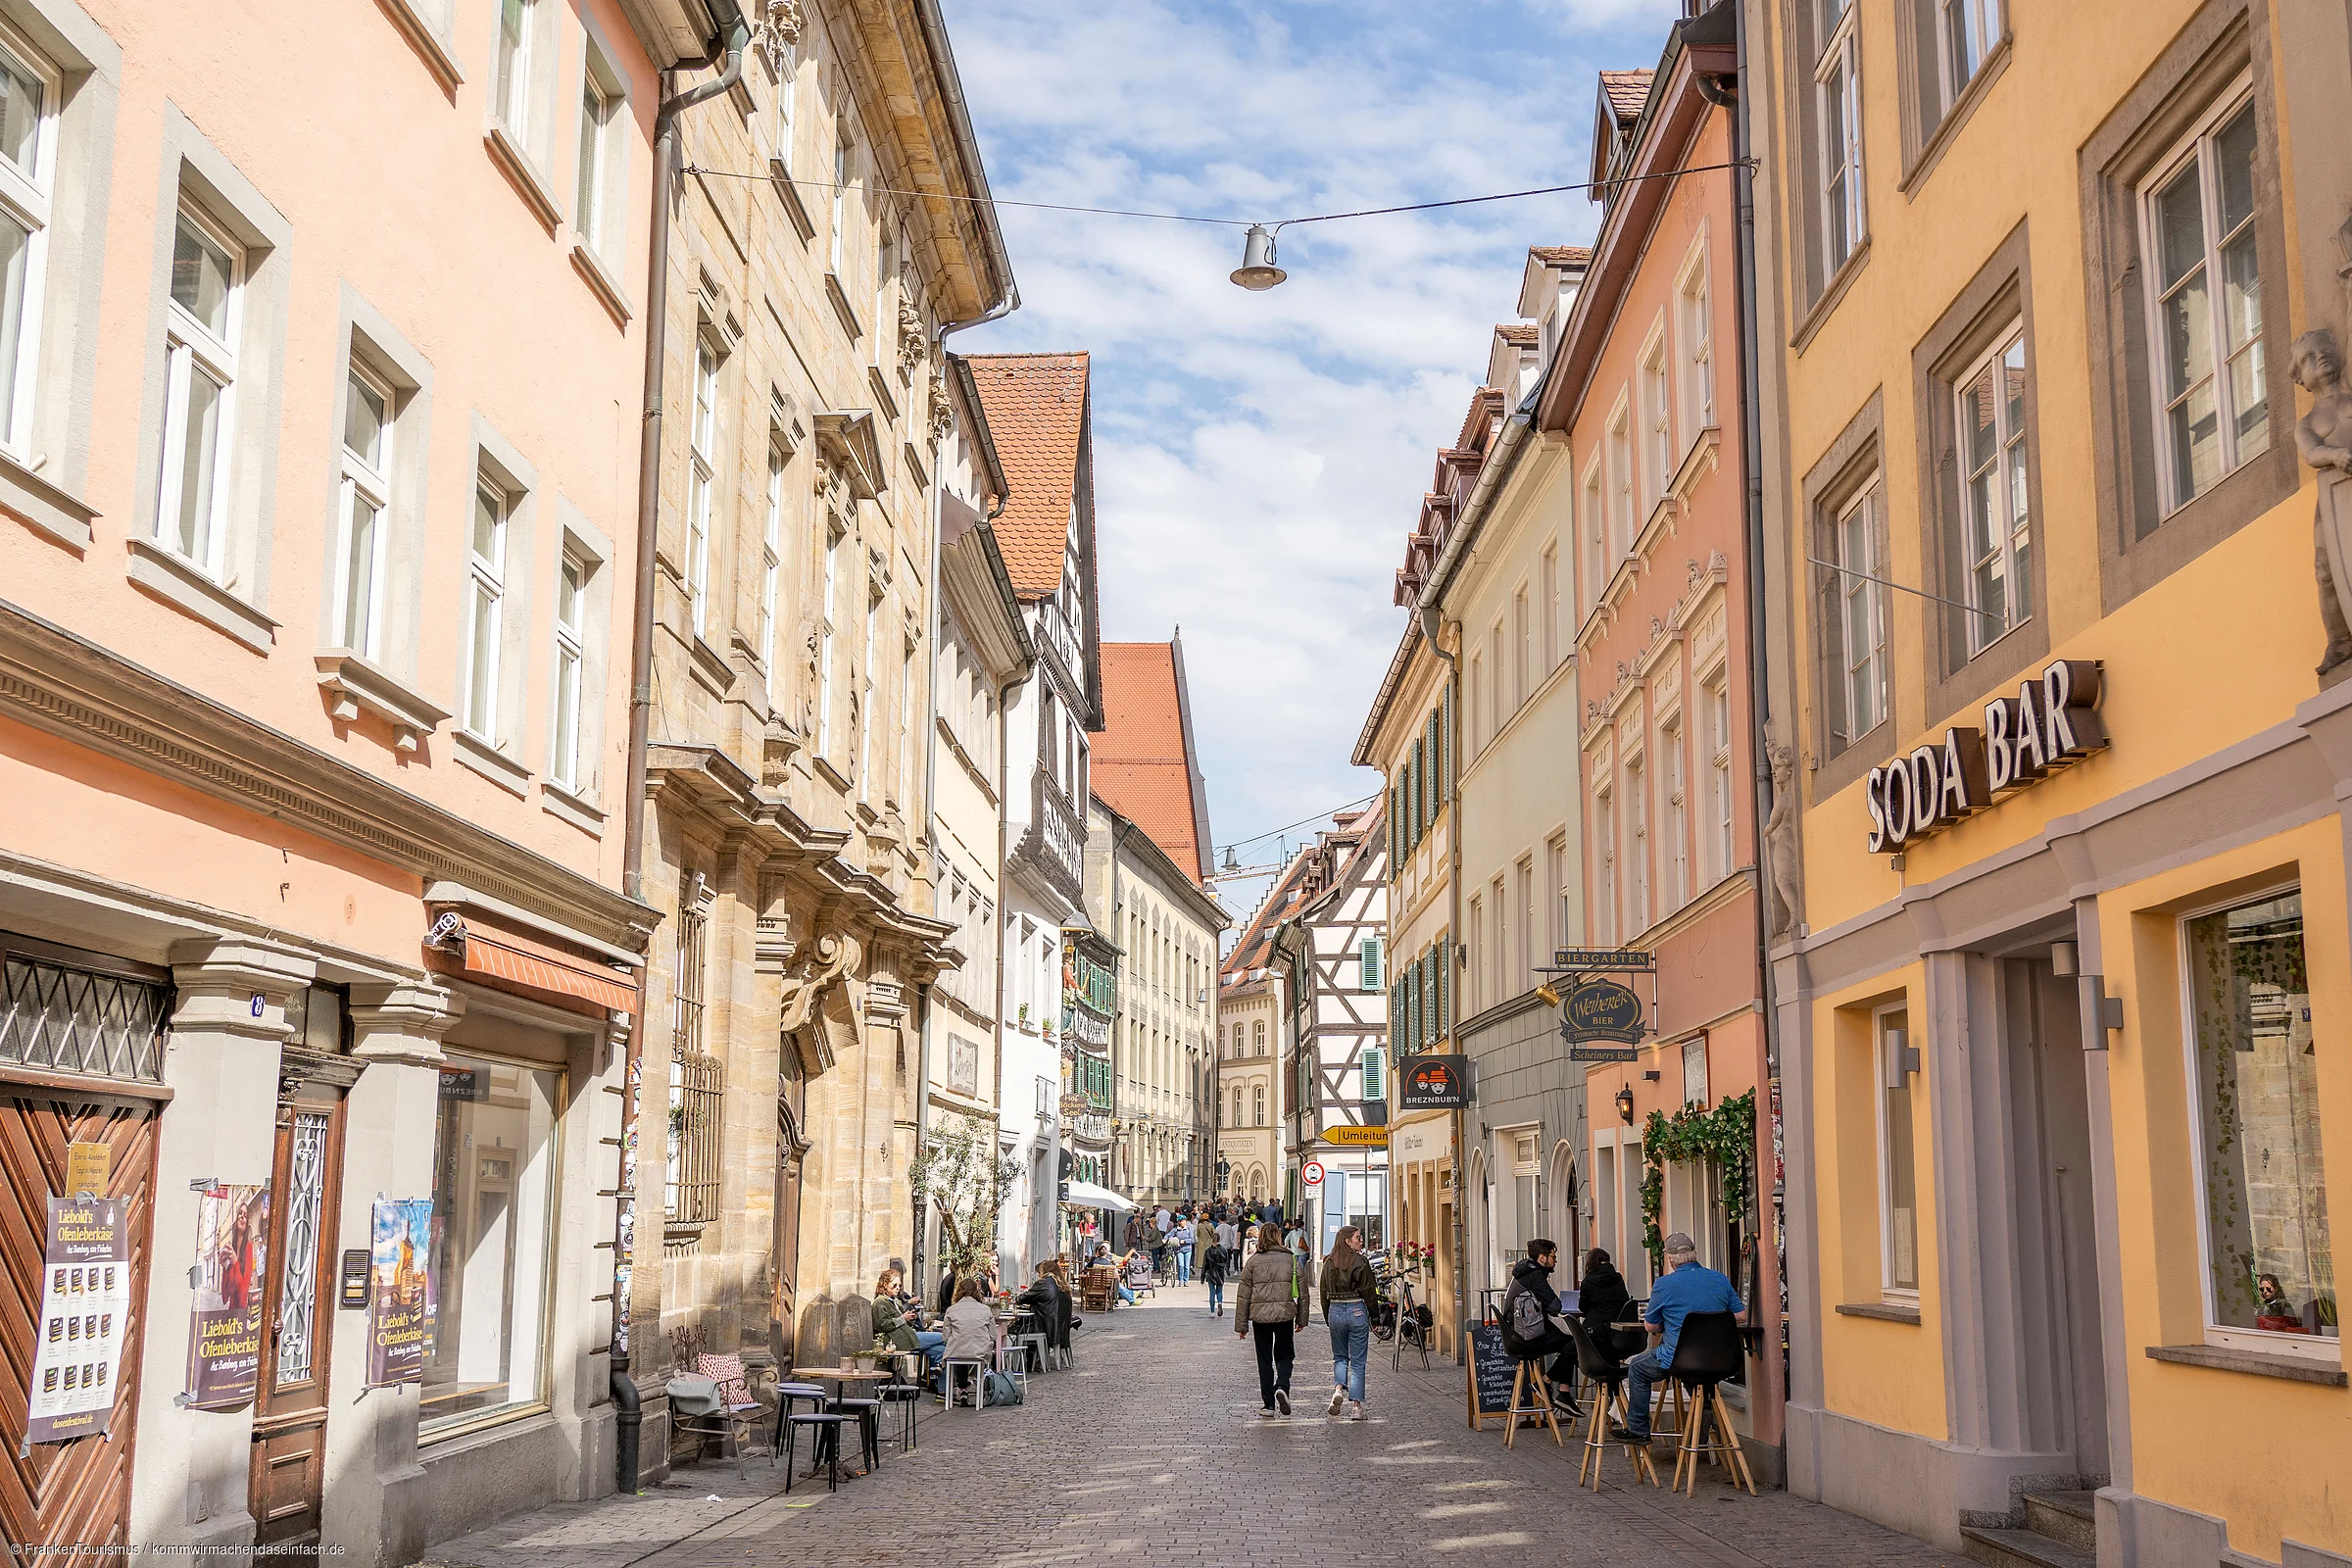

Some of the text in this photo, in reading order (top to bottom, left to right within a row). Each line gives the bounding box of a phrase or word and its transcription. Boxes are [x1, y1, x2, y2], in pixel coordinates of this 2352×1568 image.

[1867, 659, 2080, 854] SODA BAR
[1557, 954, 1645, 963] BIERGARTEN
[254, 996, 264, 1015] 8
[1574, 1051, 1614, 1059] Scheiners
[1405, 1096, 1460, 1104] BREZNBUB'N
[1343, 1131, 1388, 1141] Umleitun
[58, 1227, 114, 1242] Ofenleberkäse
[376, 1327, 422, 1347] Ofenleberkäse
